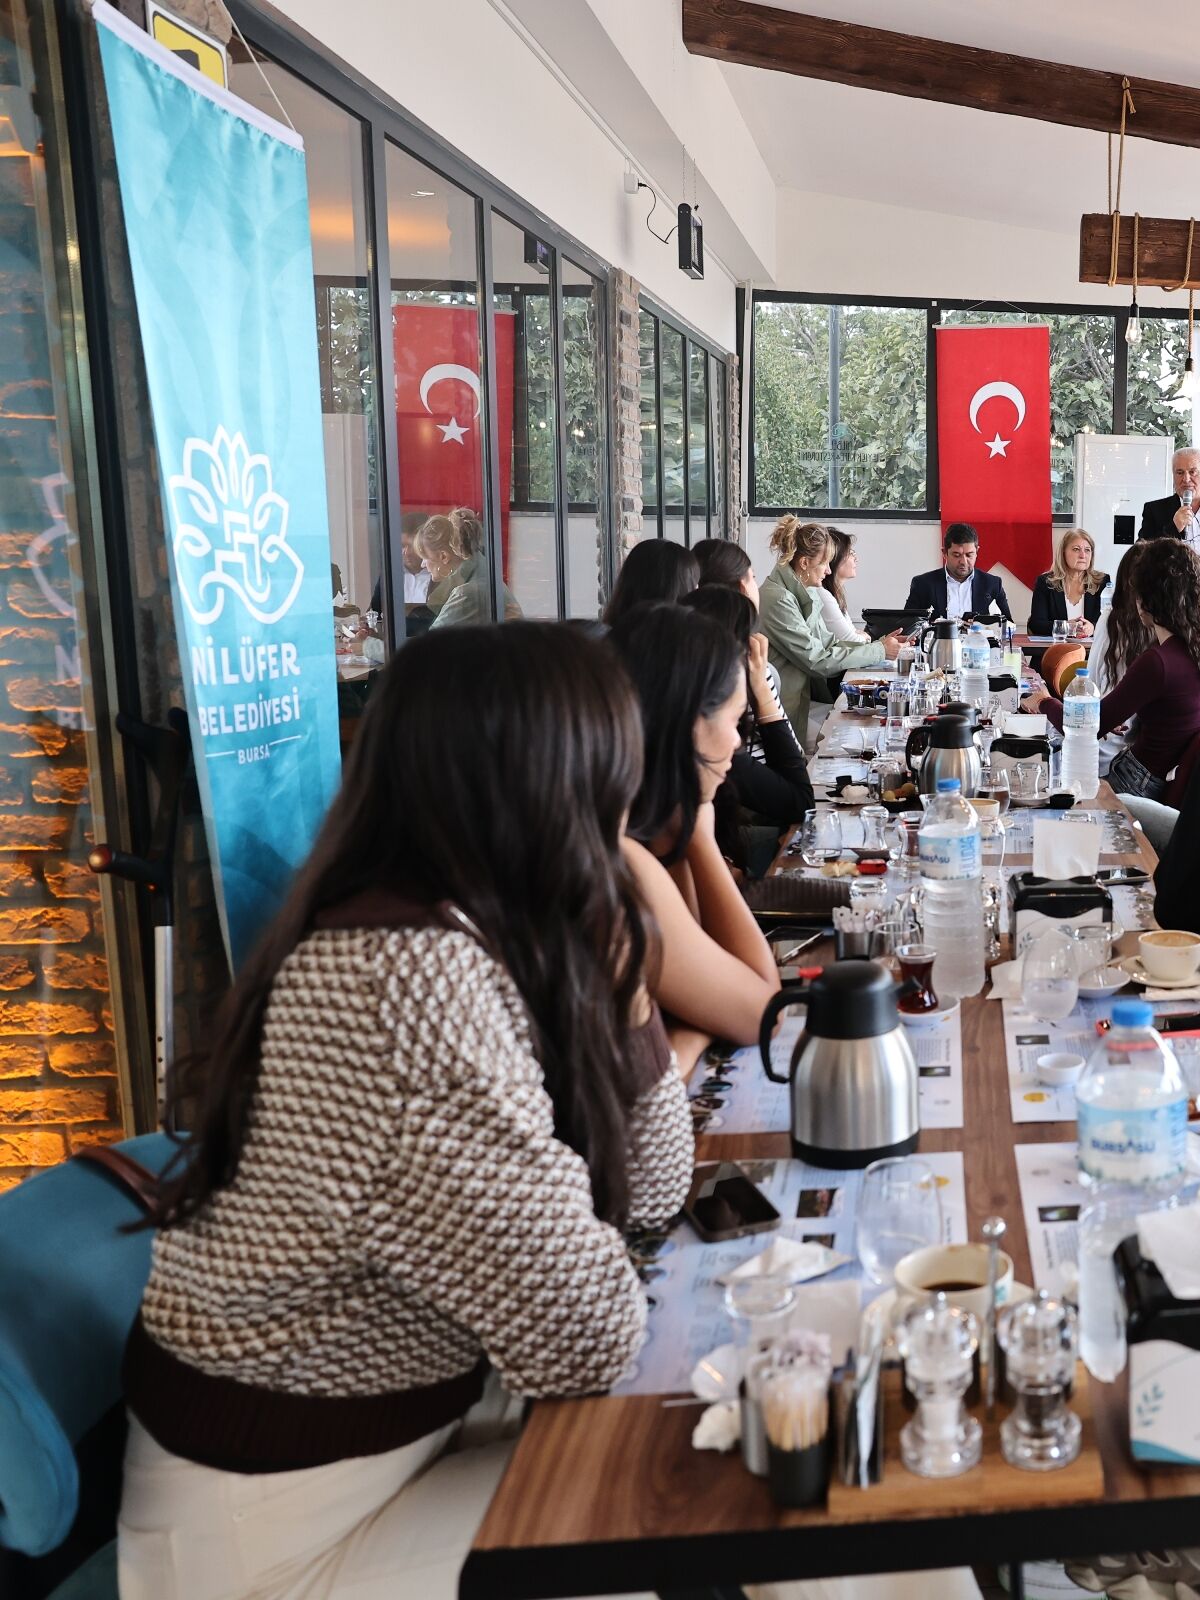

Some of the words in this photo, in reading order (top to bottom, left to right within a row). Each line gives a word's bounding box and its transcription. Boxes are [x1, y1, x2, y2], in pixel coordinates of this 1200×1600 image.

[191, 635, 300, 686] NİLÜFER
[198, 686, 300, 737] BELEDİYESİ
[237, 744, 270, 765] BURSA
